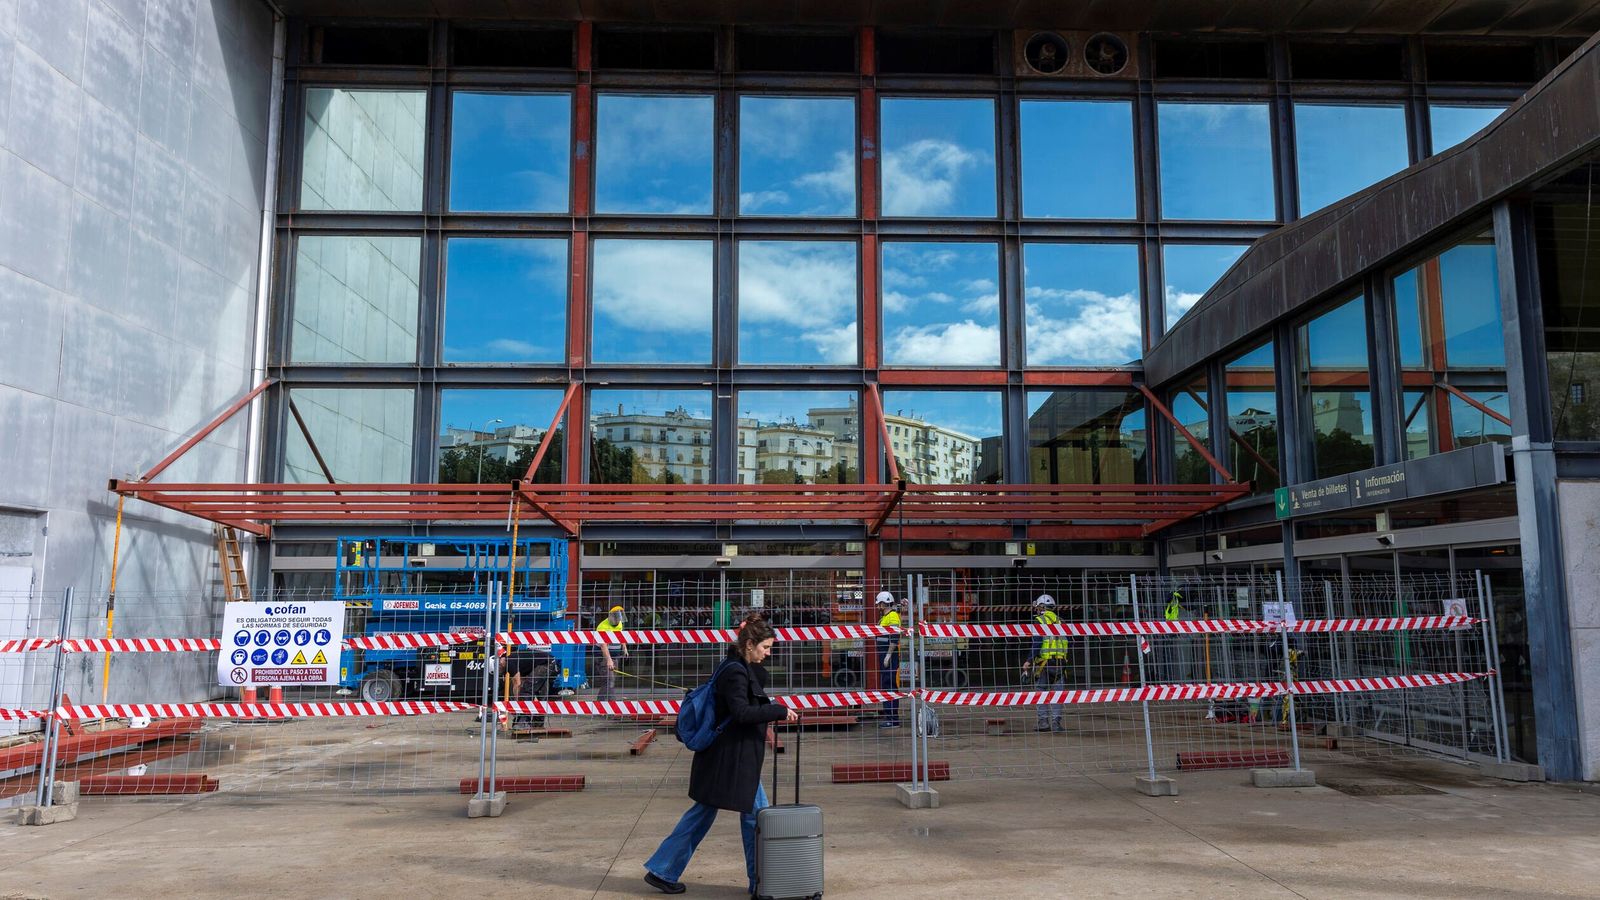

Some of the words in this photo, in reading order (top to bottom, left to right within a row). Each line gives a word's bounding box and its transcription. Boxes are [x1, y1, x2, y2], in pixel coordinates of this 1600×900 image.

[1365, 470, 1405, 488] Información
[1302, 489, 1317, 500] Venta
[1318, 488, 1325, 496] de
[1326, 483, 1347, 495] billetes
[274, 604, 306, 614] cofan
